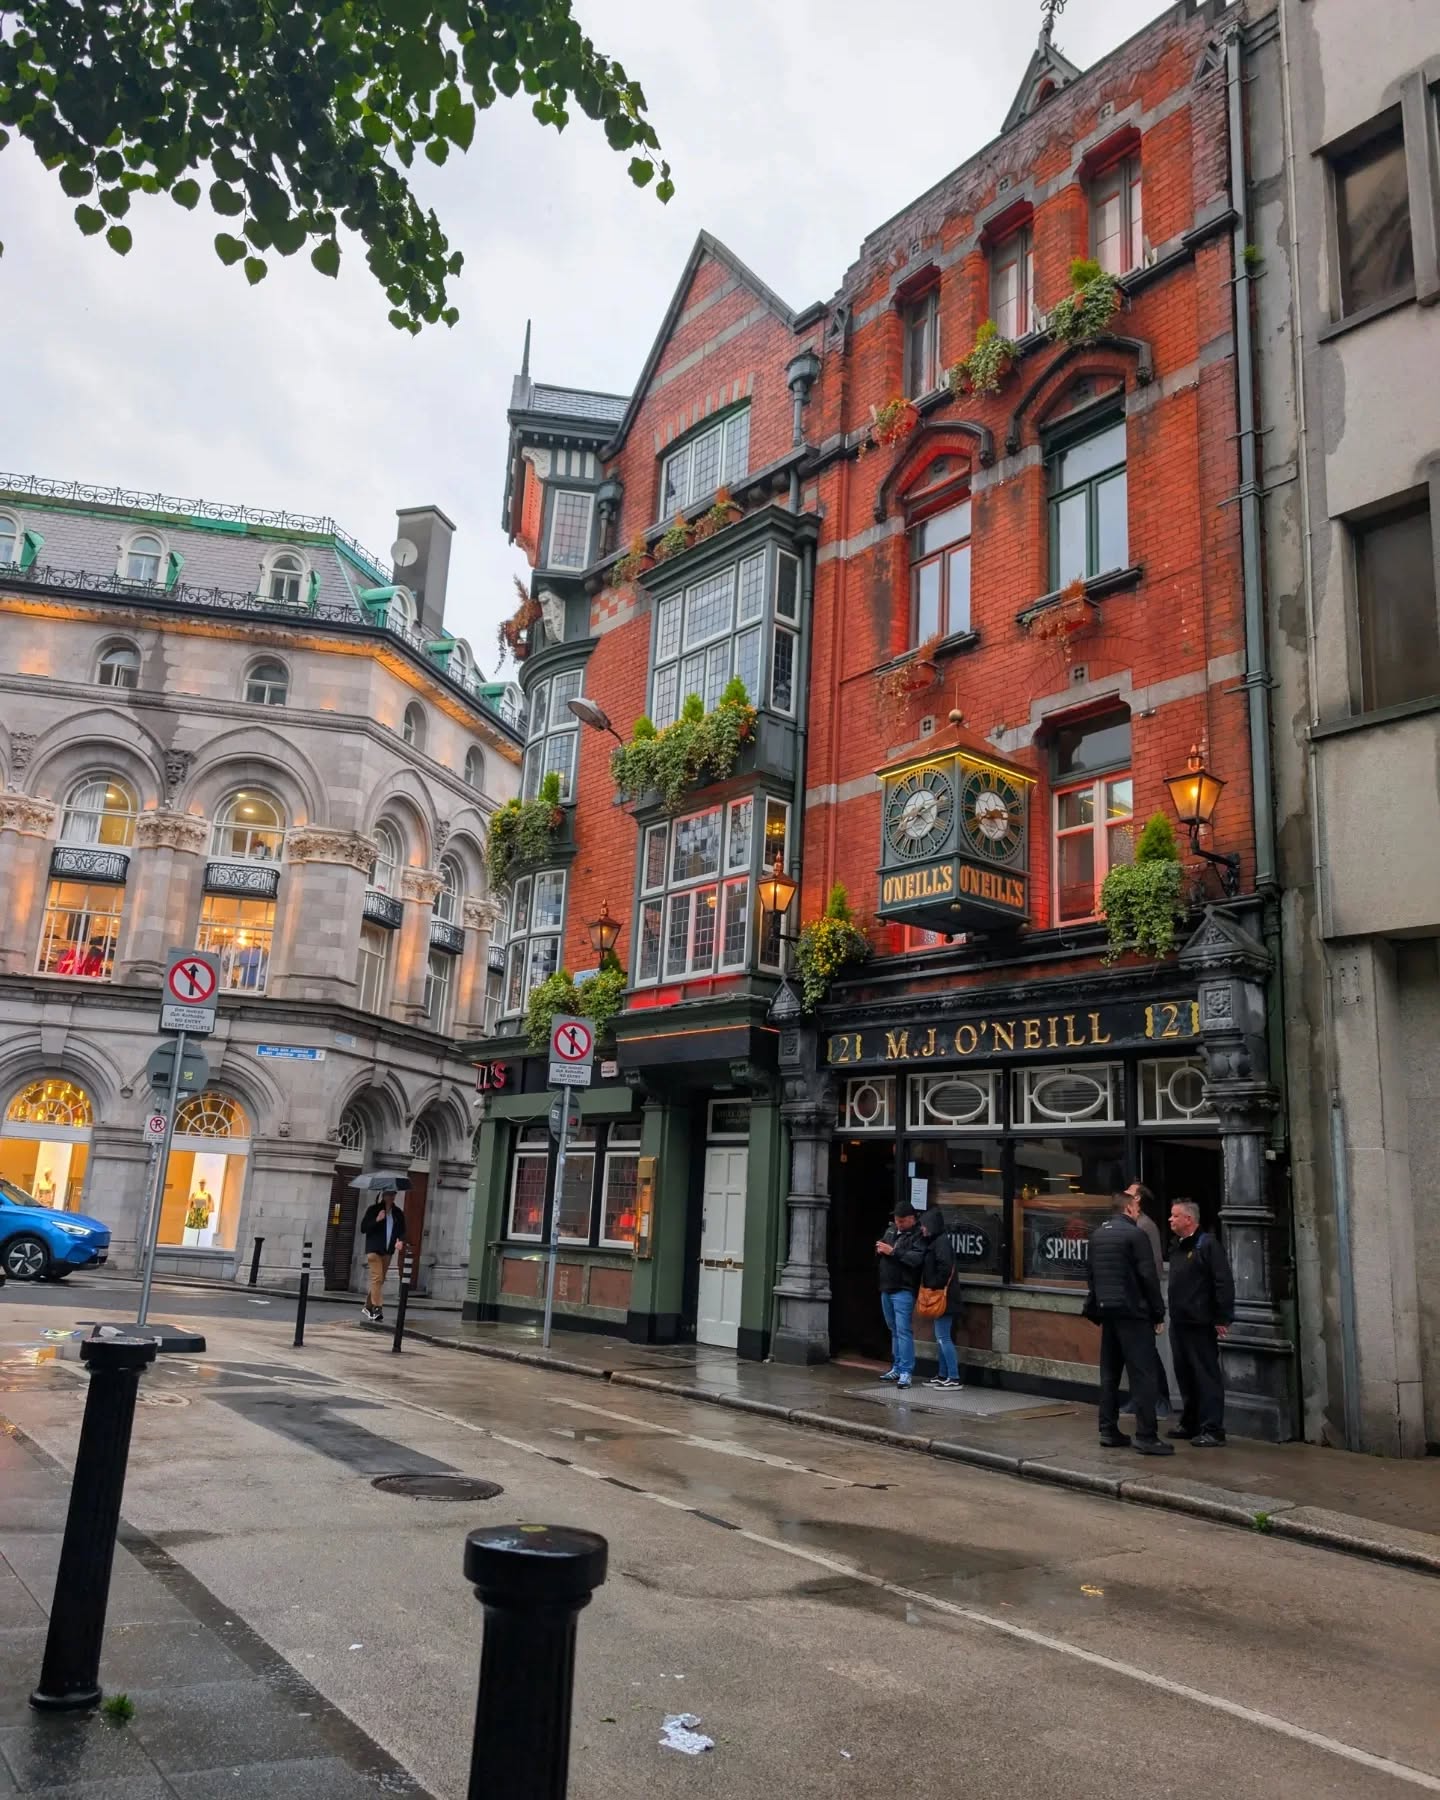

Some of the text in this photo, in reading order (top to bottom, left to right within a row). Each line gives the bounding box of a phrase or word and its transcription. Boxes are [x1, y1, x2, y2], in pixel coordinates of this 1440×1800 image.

[883, 865, 952, 904] O'NEILL'S
[960, 865, 1024, 908] O'NEILL'S
[838, 1036, 850, 1062] 2
[954, 1012, 1111, 1054] O'NEILL
[1161, 1004, 1180, 1037] 2
[947, 1233, 983, 1256] INES
[1045, 1237, 1090, 1260] SPIRIT
